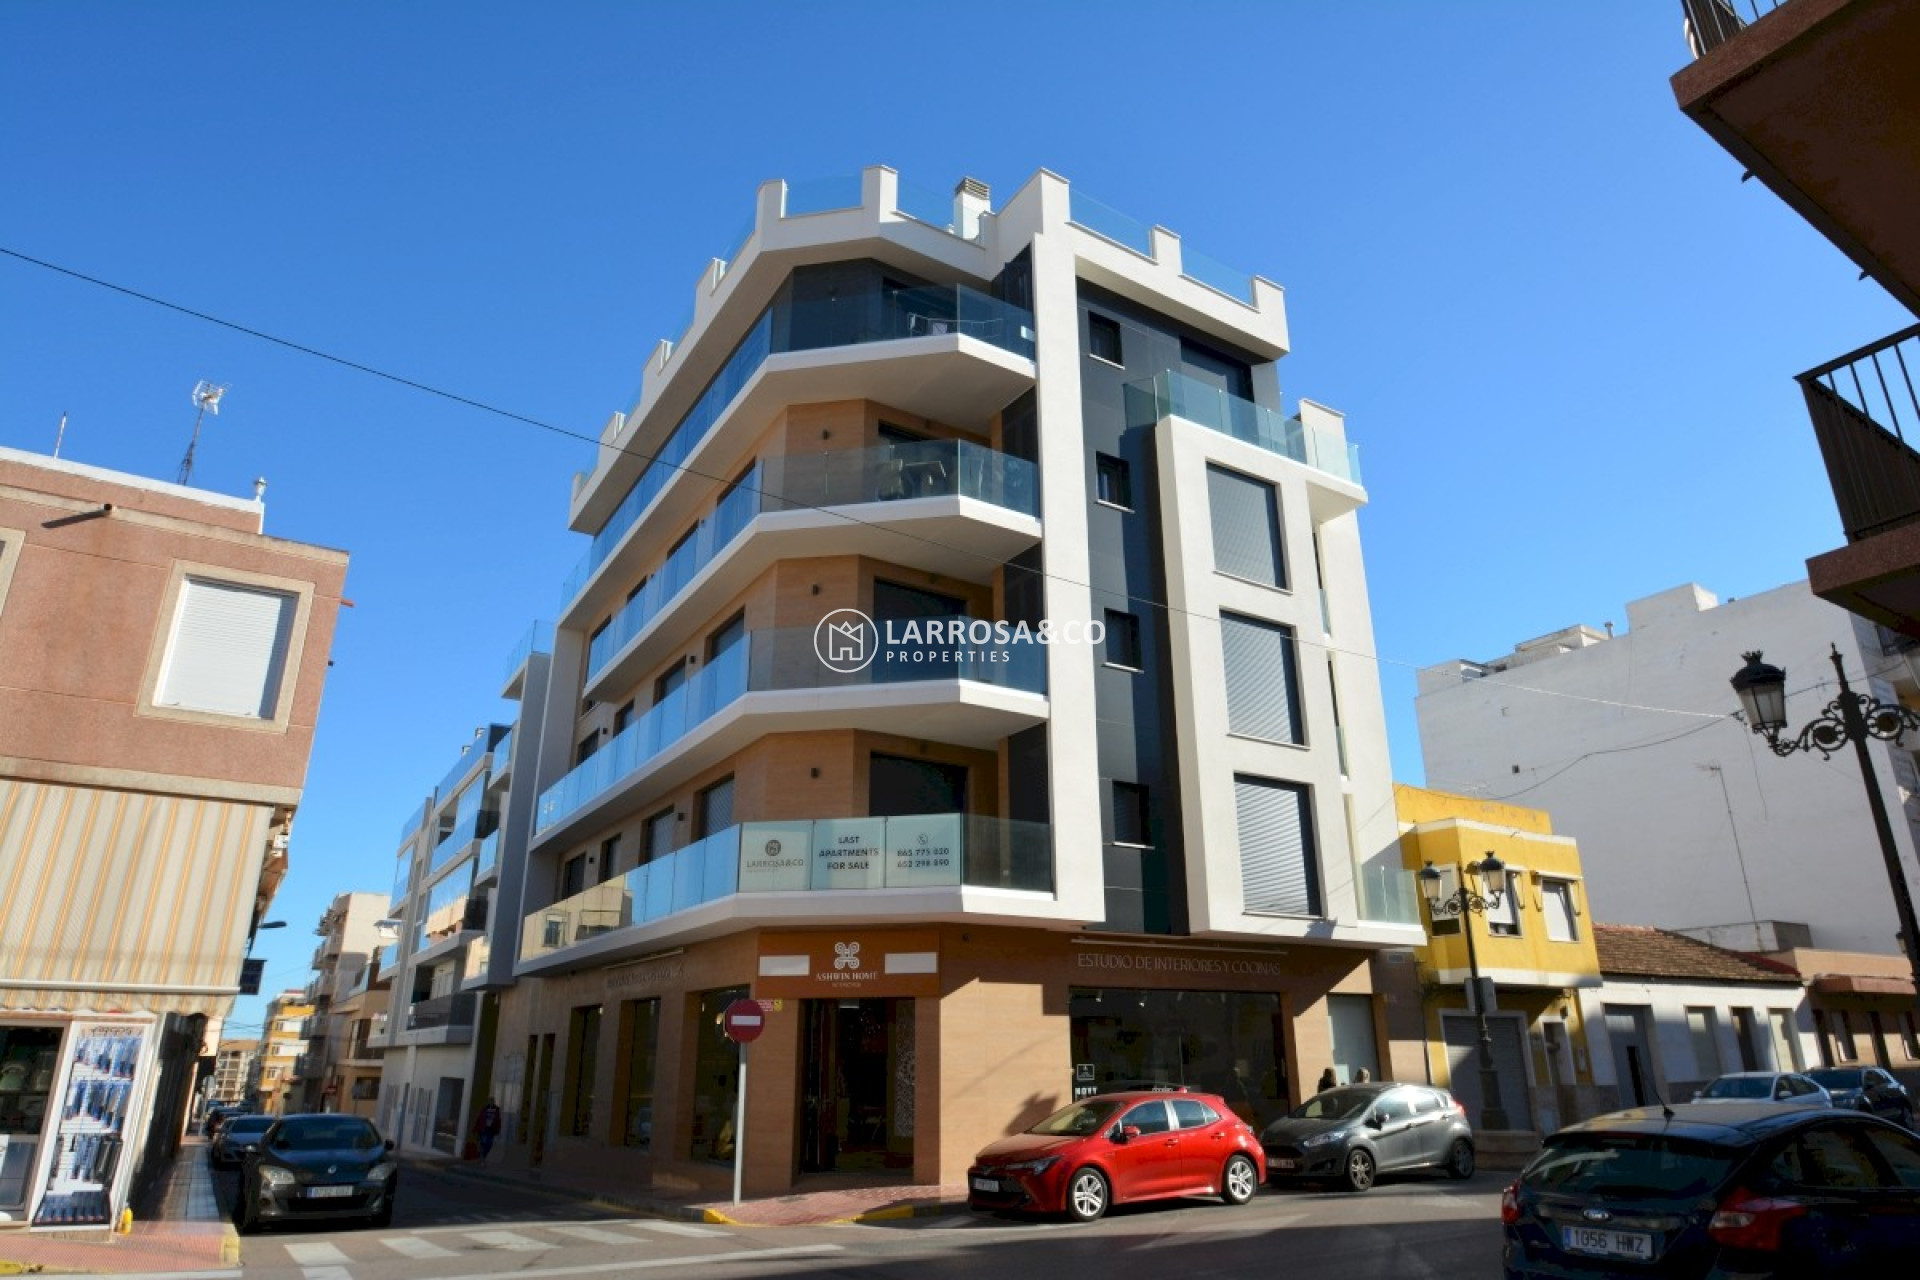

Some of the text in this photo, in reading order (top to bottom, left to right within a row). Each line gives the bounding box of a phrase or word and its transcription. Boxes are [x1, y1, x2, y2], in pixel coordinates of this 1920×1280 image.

[838, 836, 860, 844] LAST
[818, 847, 879, 858] APARTMENTS
[826, 861, 870, 871] FOR SALE
[1077, 952, 1133, 970] ESTUDIO
[1135, 955, 1152, 970] DE
[1154, 956, 1221, 974] INTERIORES
[1221, 958, 1231, 973] Y
[1575, 1230, 1608, 1249] 1056
